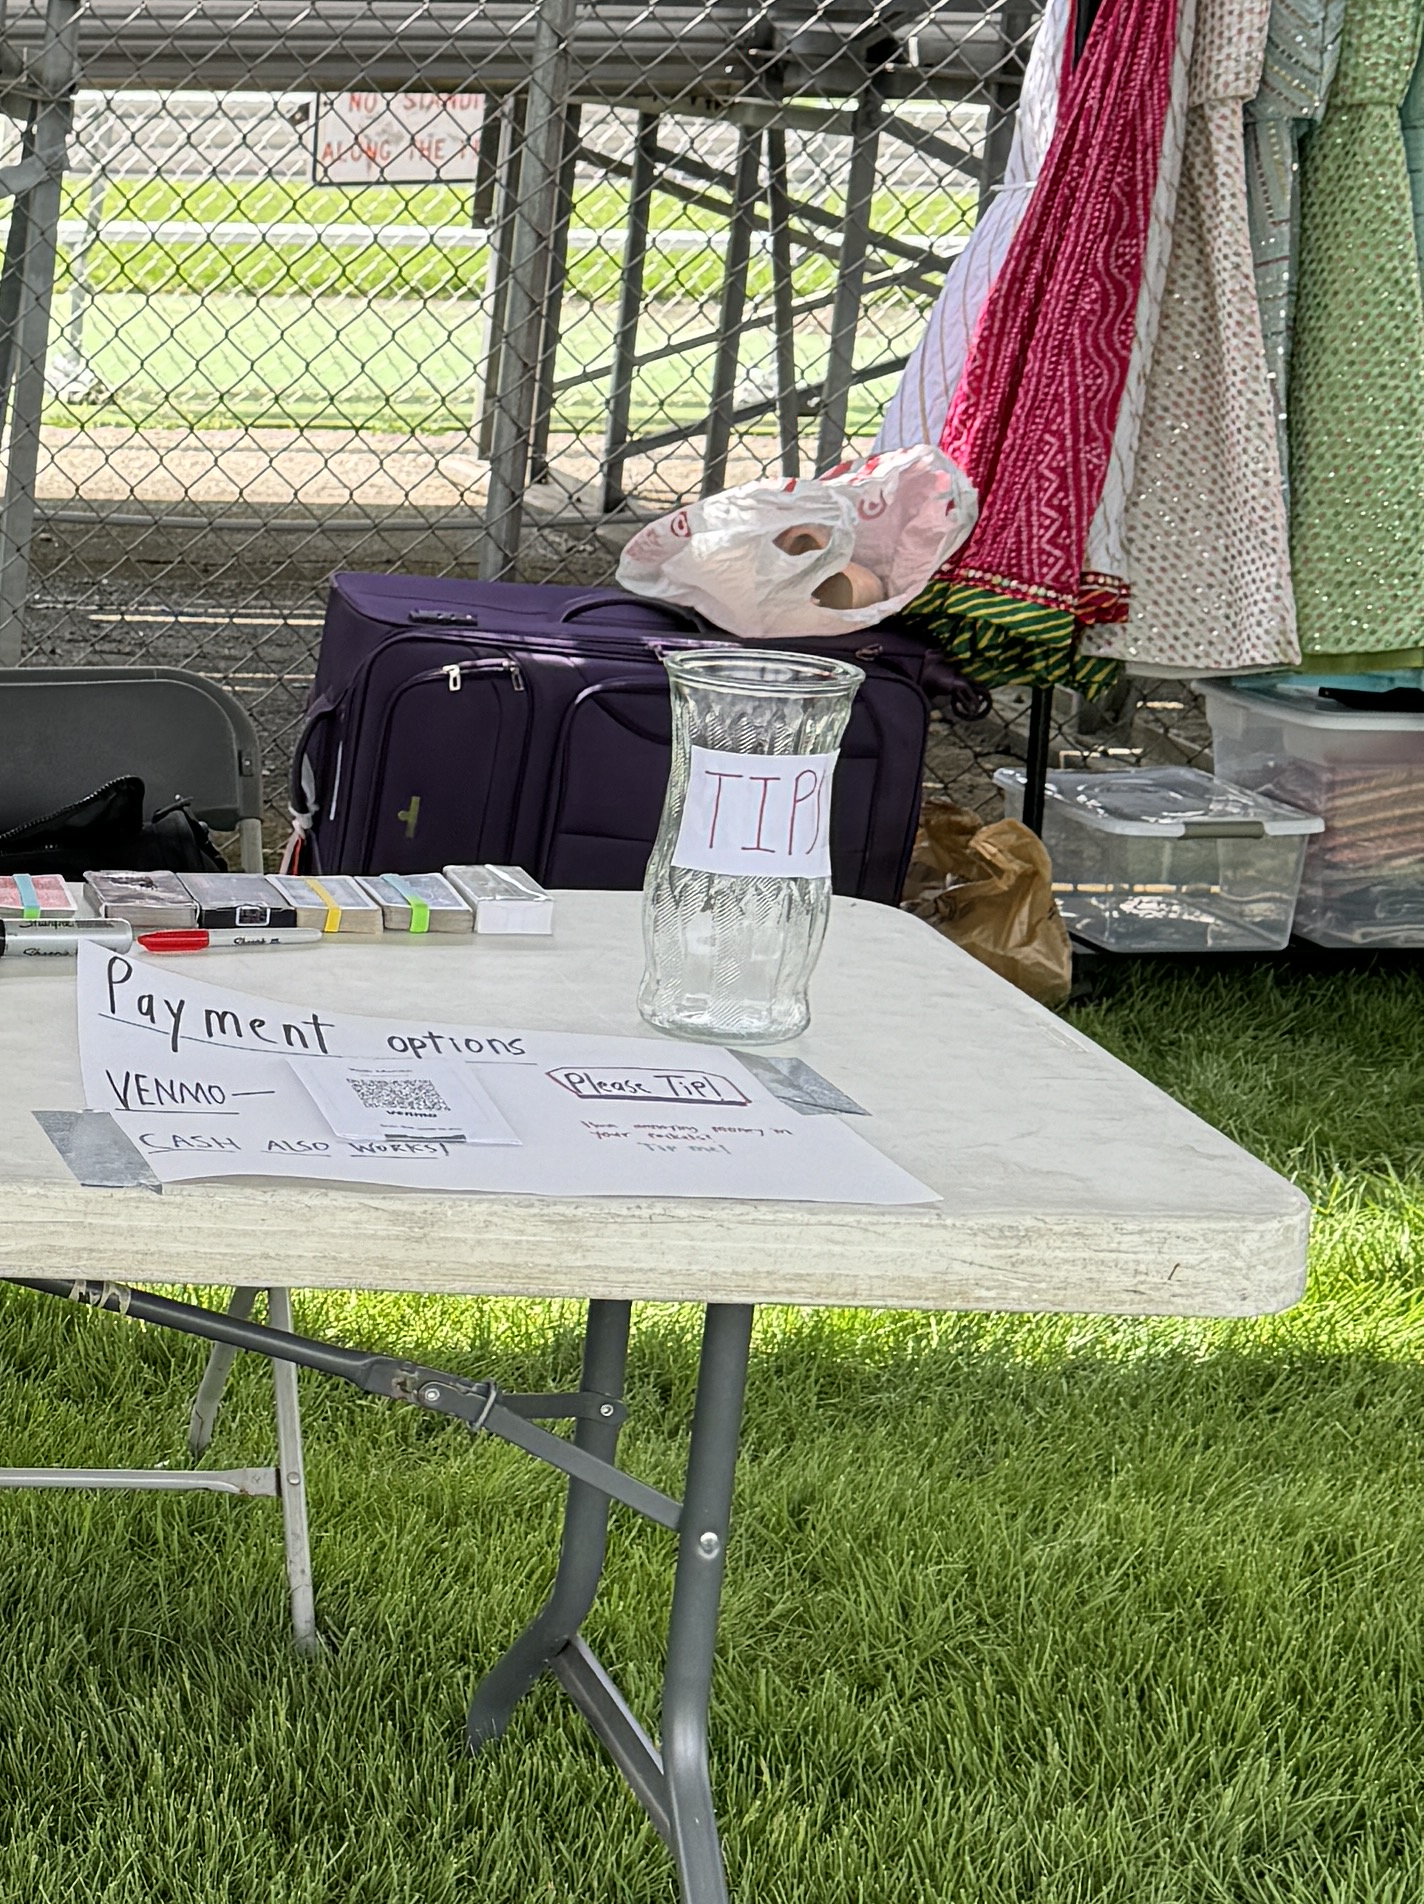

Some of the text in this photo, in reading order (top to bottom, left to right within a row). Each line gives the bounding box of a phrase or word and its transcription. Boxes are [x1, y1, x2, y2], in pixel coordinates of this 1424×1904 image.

[321, 139, 393, 162] ALONG
[704, 768, 827, 856] TIPS
[107, 956, 527, 1059] Payment options
[564, 1071, 726, 1102] Please Tip!
[139, 1132, 450, 1157] CASH ALSO WORKS!
